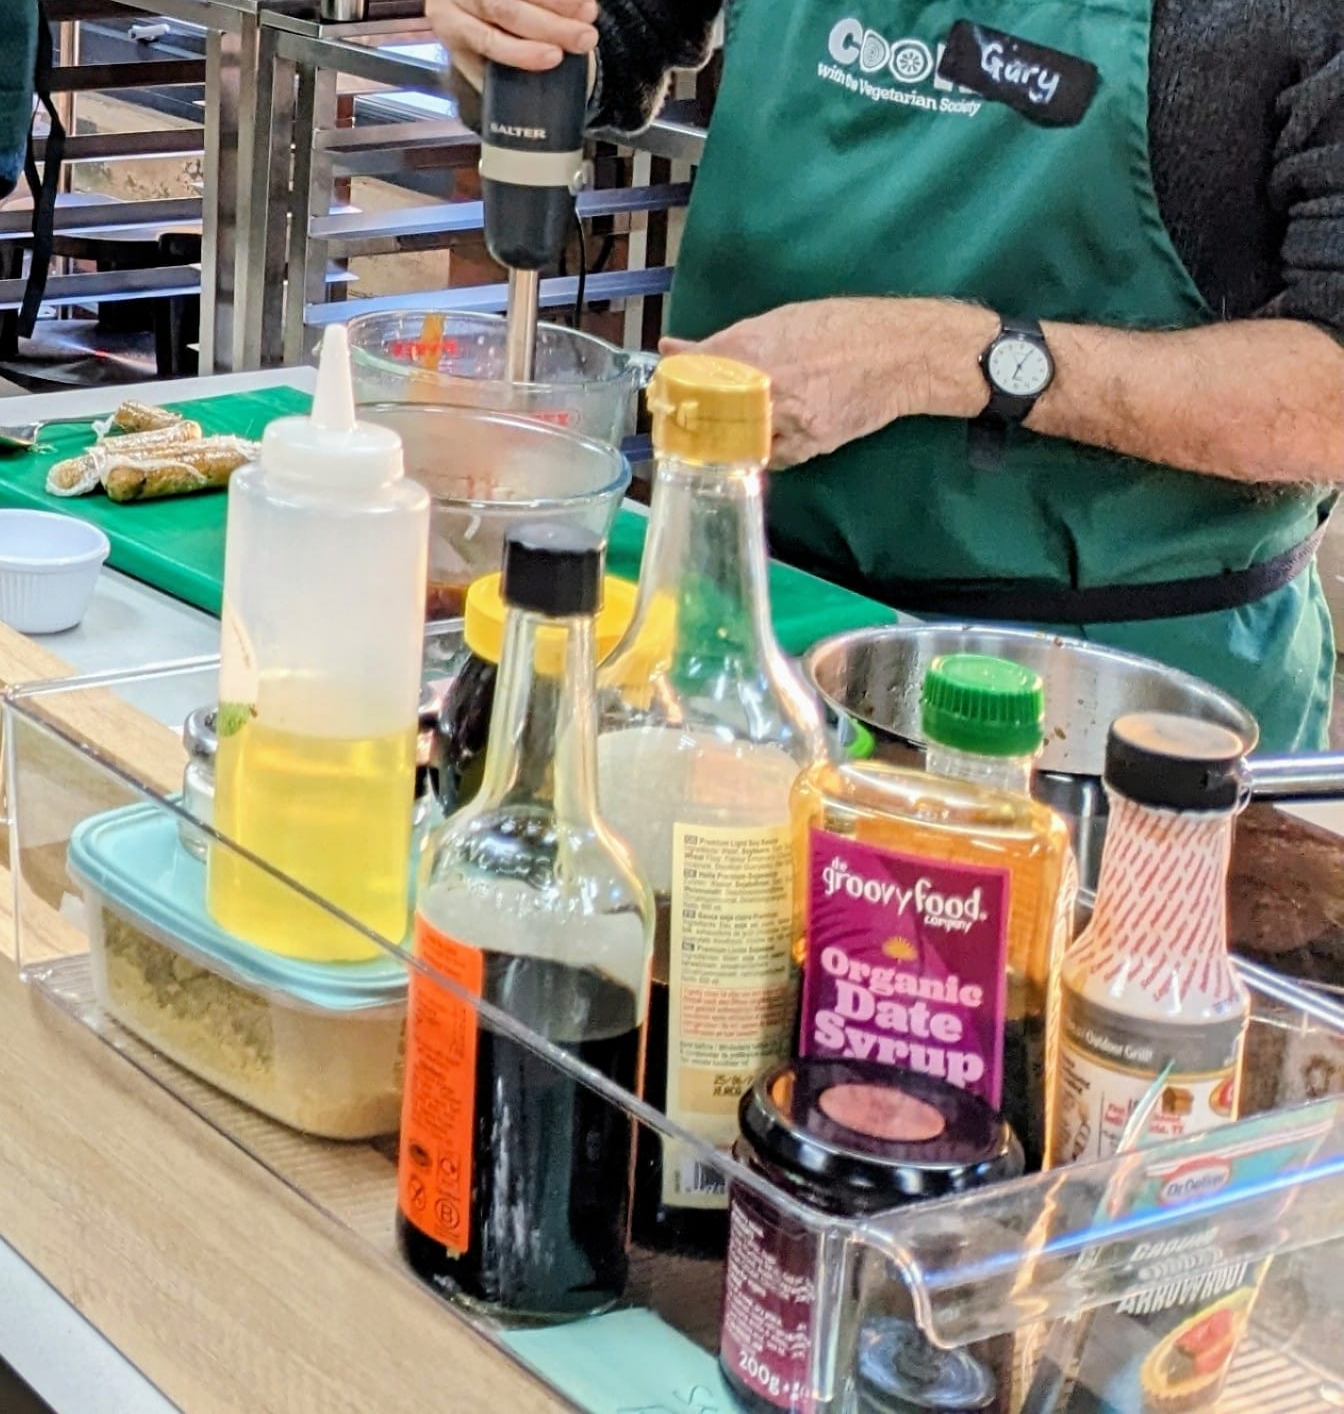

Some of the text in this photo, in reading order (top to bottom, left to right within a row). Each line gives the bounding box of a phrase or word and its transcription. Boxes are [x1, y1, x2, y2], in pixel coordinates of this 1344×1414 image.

[817, 62, 846, 88] with
[978, 39, 1060, 104] Gary
[491, 122, 546, 139] SALTER
[820, 946, 983, 1008] Organic
[834, 979, 963, 1043] Date
[814, 1009, 985, 1089] Syrup
